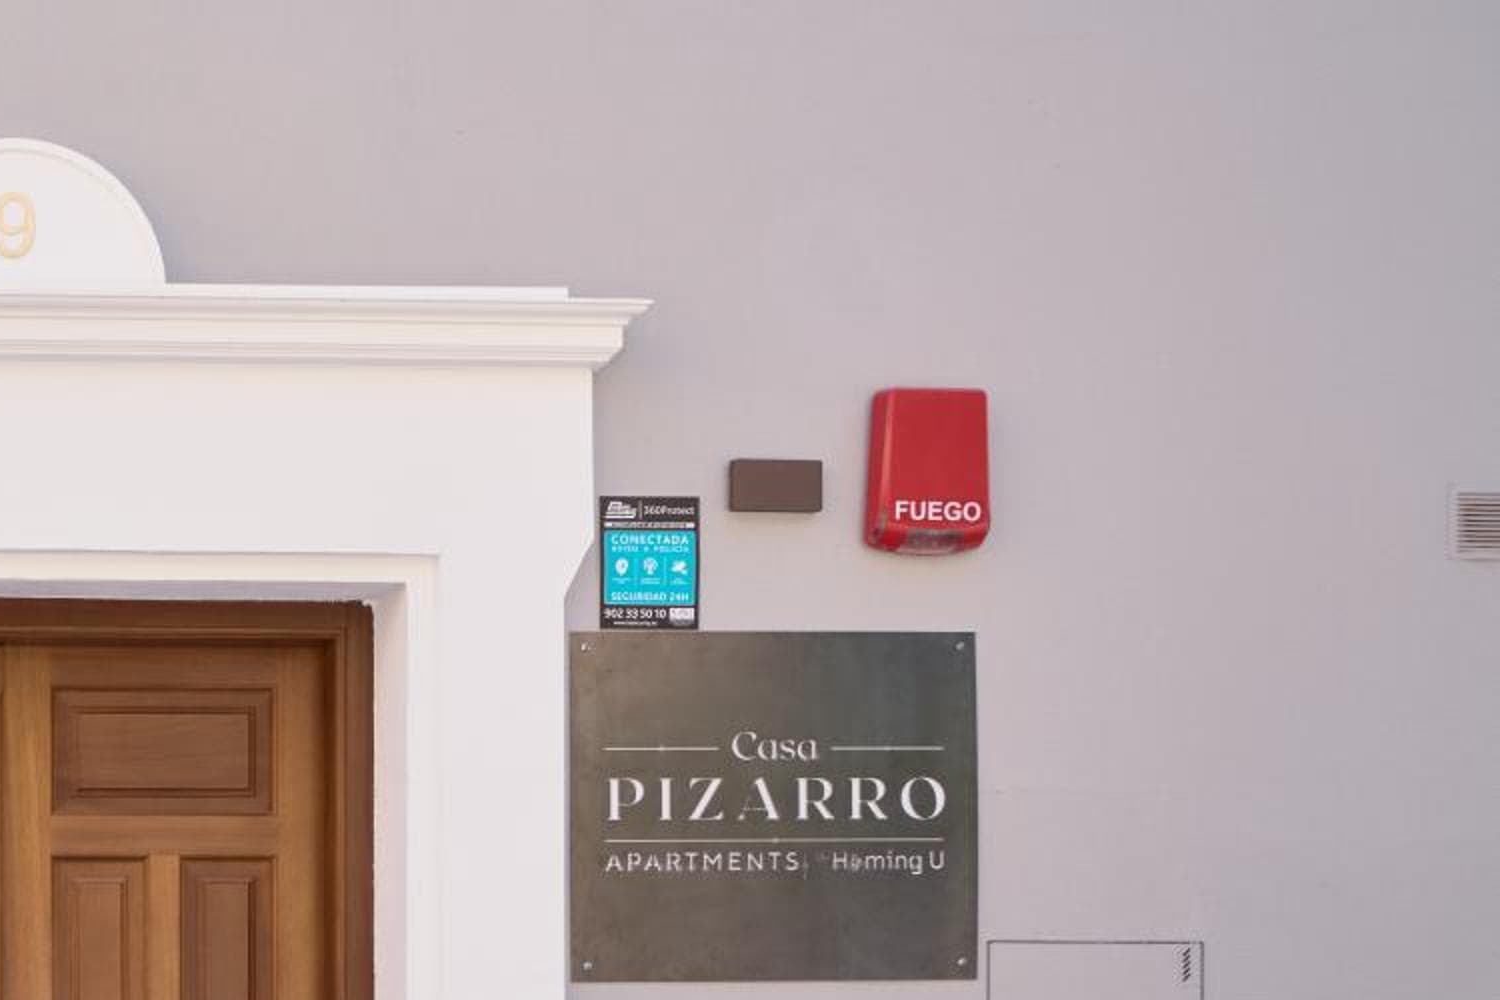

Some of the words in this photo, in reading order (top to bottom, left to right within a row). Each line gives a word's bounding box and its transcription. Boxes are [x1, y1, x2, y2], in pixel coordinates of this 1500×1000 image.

[894, 499, 982, 522] FUEGO
[611, 534, 689, 546] CONECTADA
[654, 607, 667, 619] 10
[730, 731, 819, 761] Casa
[607, 776, 947, 821] PIZARRO
[604, 851, 800, 872] APARTMENTS
